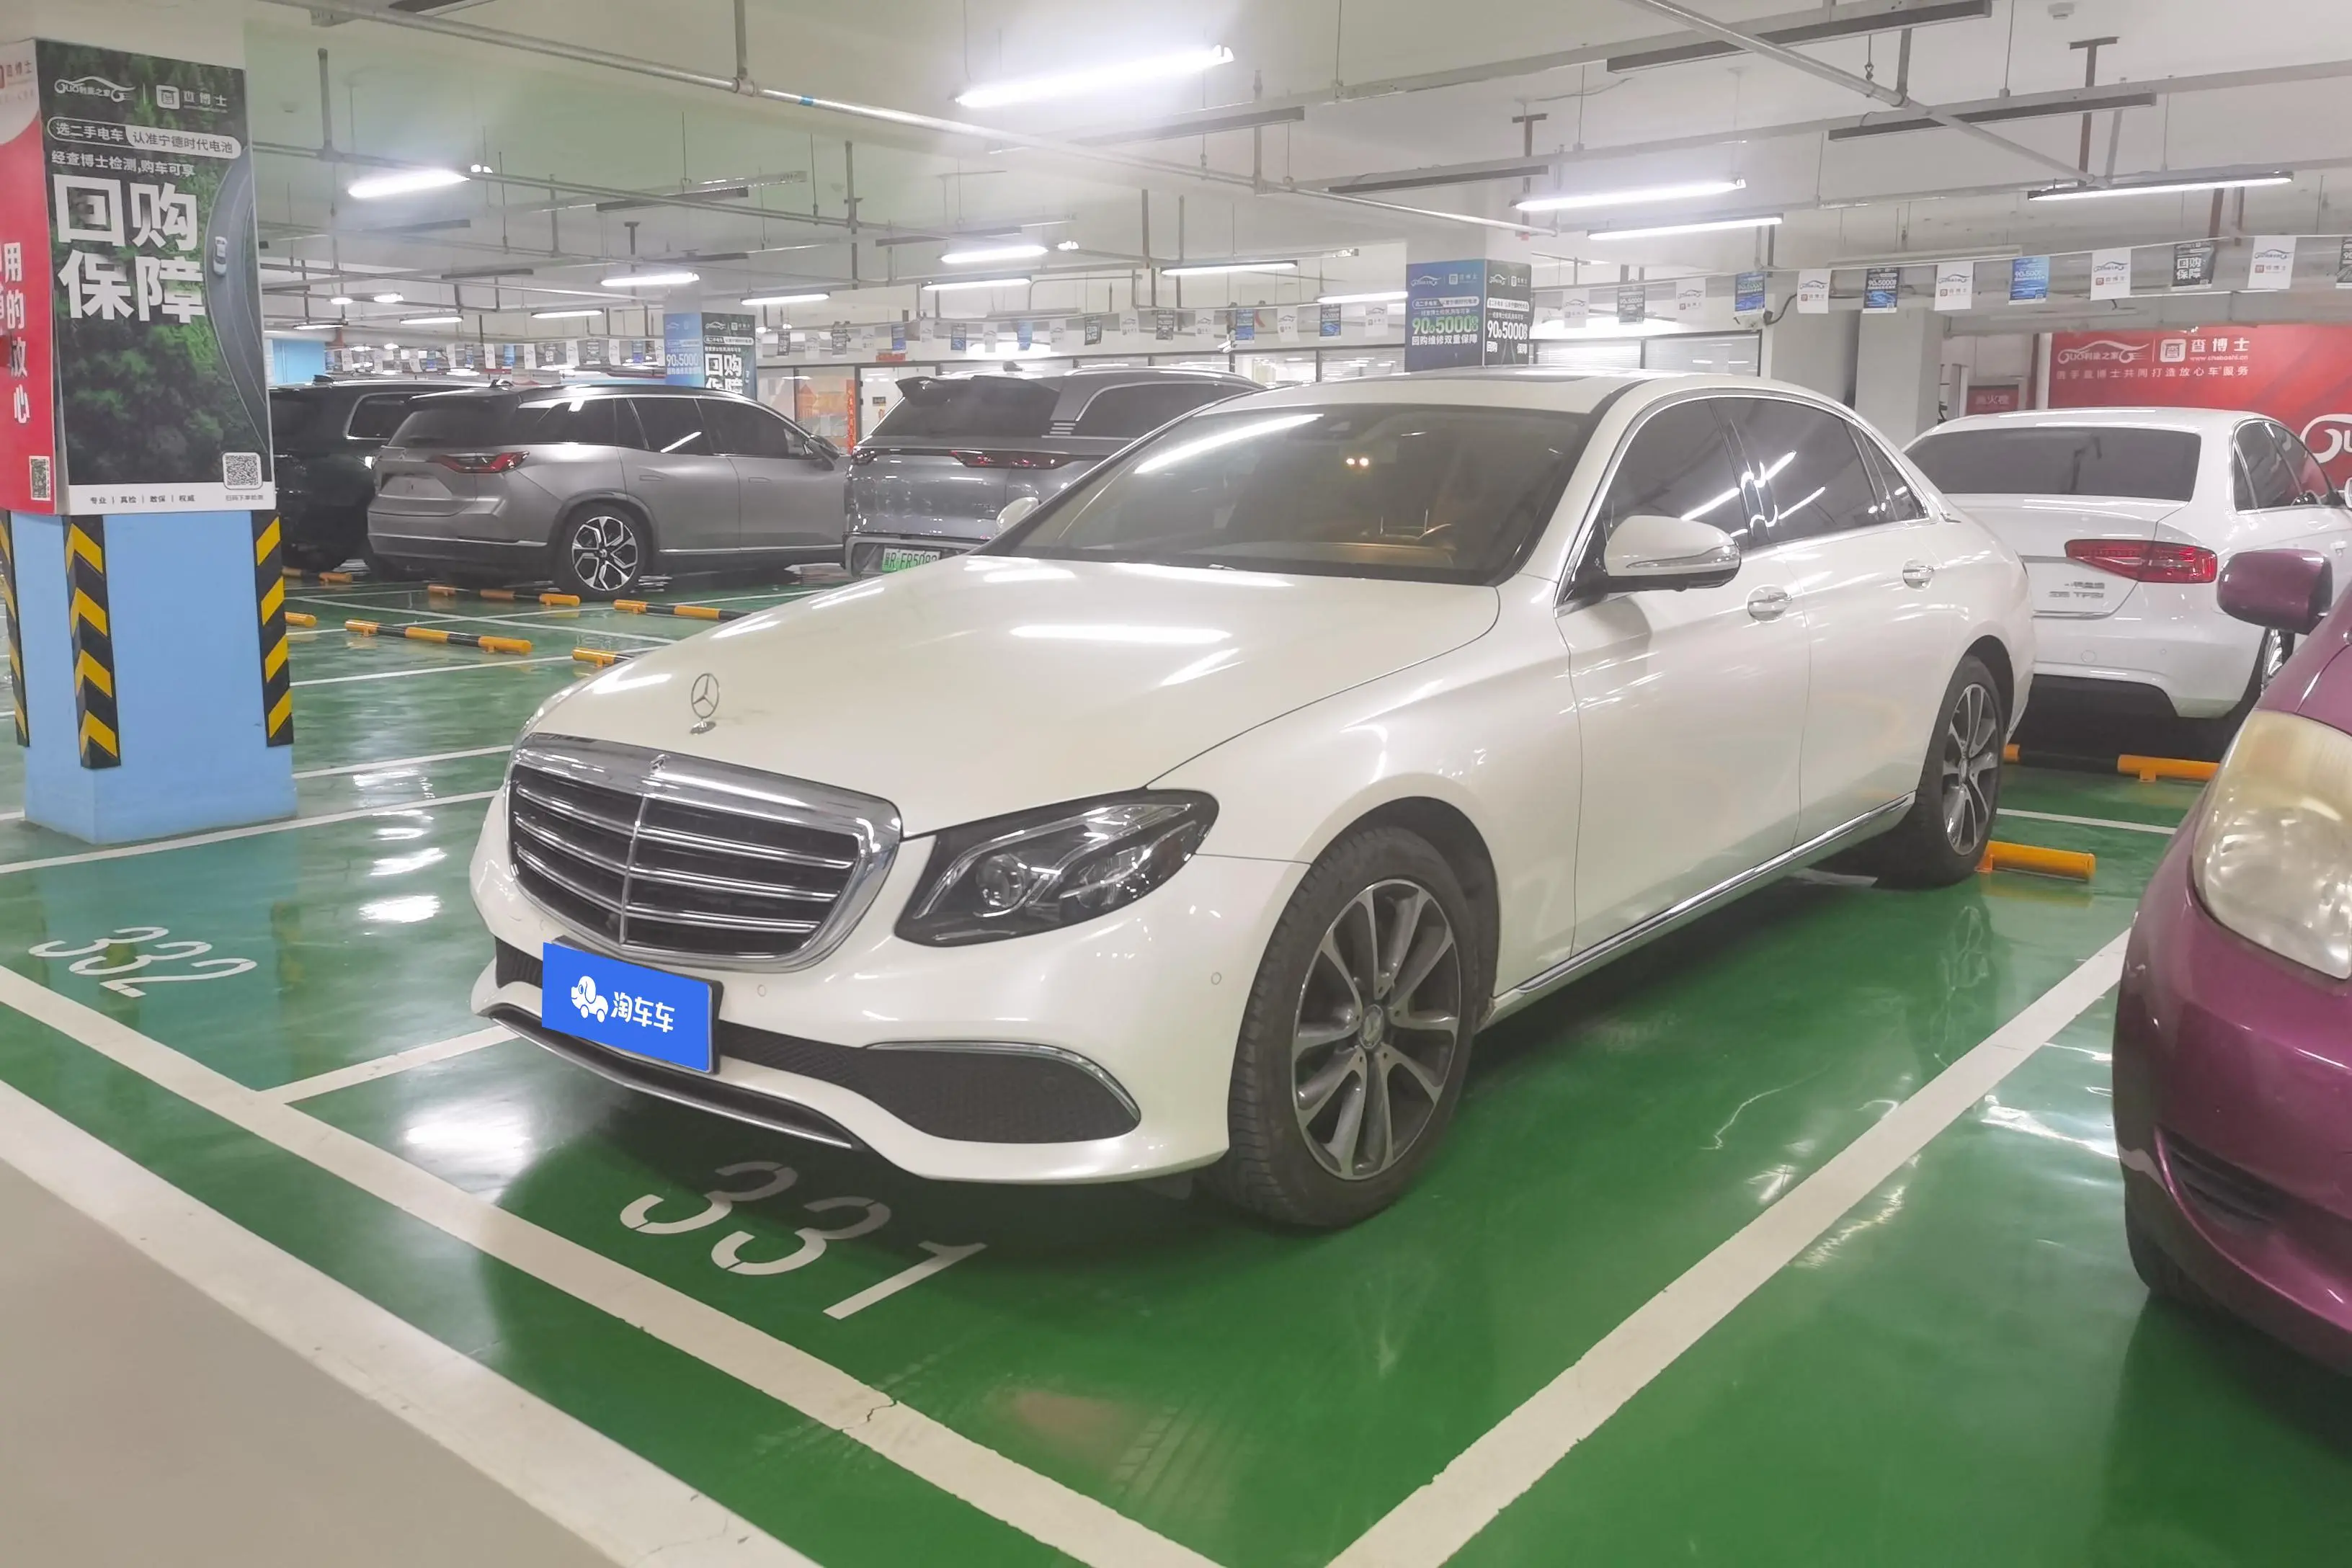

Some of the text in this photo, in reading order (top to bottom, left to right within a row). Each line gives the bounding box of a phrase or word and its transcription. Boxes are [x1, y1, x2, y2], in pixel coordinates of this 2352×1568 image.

[184, 91, 227, 107] 查博士
[55, 122, 233, 153] 选二手电车 认准宁德时代电池
[51, 150, 195, 177] 经查博士检测,购车可享
[53, 174, 197, 251] 回购
[2177, 257, 2201, 269] 回购
[58, 250, 205, 323] 保障
[2191, 337, 2249, 352] 查博士
[705, 353, 742, 376] 回购
[28, 927, 257, 997] 332
[620, 1161, 988, 1319] 331
